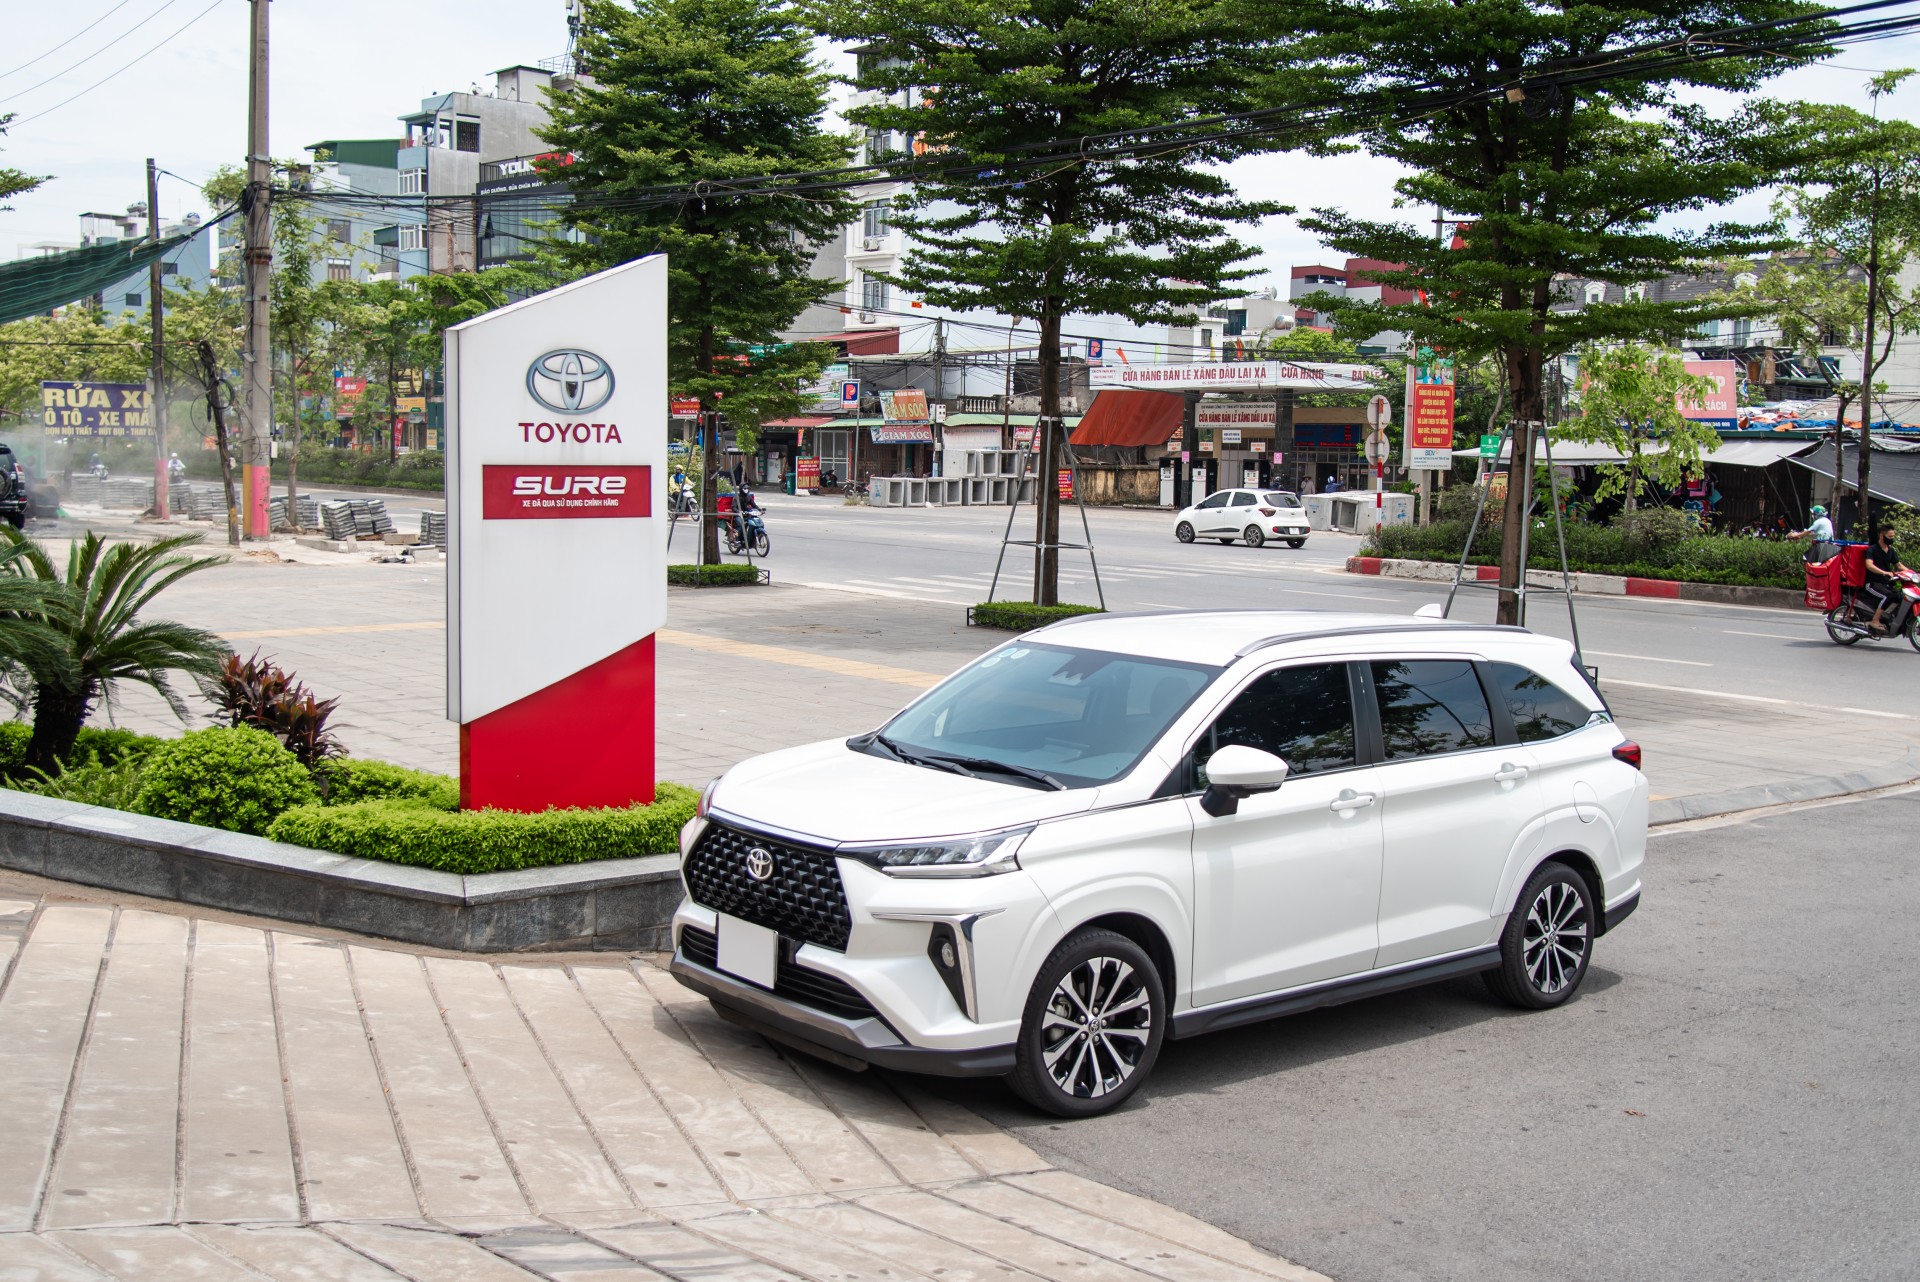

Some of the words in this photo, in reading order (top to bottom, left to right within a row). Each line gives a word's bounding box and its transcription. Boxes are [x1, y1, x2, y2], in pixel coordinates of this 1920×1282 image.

[1122, 366, 1138, 382] CỬA
[1140, 367, 1161, 381] HÀNG
[1163, 367, 1180, 381] BÁN
[1193, 366, 1216, 380] XĂNG
[1238, 366, 1251, 379] LAI
[43, 383, 111, 408] RỬA
[44, 407, 57, 425] Ô
[61, 407, 82, 425] TÔ
[99, 411, 120, 426] XE
[125, 409, 150, 426] MÁ
[908, 398, 925, 418] SÓC
[518, 422, 622, 443] TOYOTA
[882, 428, 907, 440] GIẢM
[910, 428, 930, 440] XÓC
[512, 476, 627, 495] SURE
[522, 499, 531, 507] XE
[532, 498, 541, 507] ĐÃ
[542, 499, 555, 507] QUA
[556, 497, 565, 507] SỬ
[566, 499, 583, 508] DỤNG
[584, 498, 602, 507] CHÍNH
[603, 498, 619, 506] HÃNG
